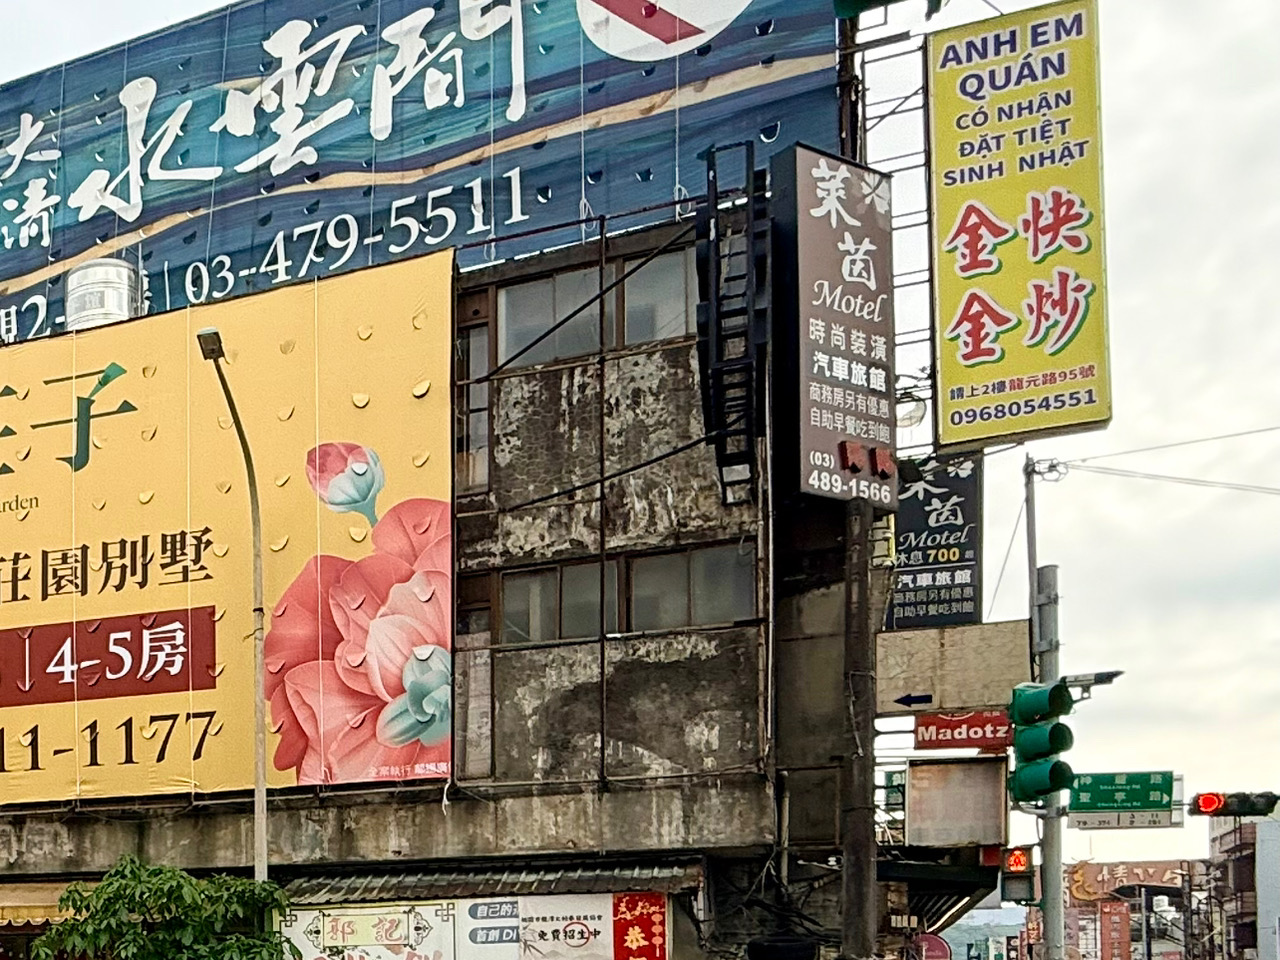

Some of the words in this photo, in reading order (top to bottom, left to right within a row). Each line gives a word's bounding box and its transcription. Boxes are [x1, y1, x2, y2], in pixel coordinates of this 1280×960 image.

[939, 29, 1017, 69] ANH
[1031, 13, 1083, 48] EM
[959, 52, 1065, 101] QUÁN
[956, 105, 989, 130] CÓ
[997, 90, 1072, 122] NHẬN
[944, 161, 1004, 186] SINH
[1019, 140, 1089, 172] NHẬT
[959, 133, 1006, 158] ĐẶT
[185, 168, 530, 304] 03-479-5511
[809, 158, 877, 291] 萊茵
[811, 280, 888, 324] Motel
[808, 318, 887, 362] 時尚裝潢
[812, 351, 887, 393] 汽車旅館
[808, 381, 890, 419] 商務房另有優惠
[950, 388, 1097, 426] 0968054551
[809, 406, 891, 444] 自助早餐吃到飽
[809, 450, 835, 469] (03)
[808, 469, 891, 503] 489-1566
[897, 524, 976, 551] Motel
[926, 548, 960, 563] 700
[897, 570, 971, 589] 汽車旅館
[46, 621, 186, 688] 4-5房
[917, 723, 1009, 741] Madotz
[327, 917, 405, 943] 郭記
[502, 928, 520, 941] DI
[537, 928, 602, 941] 免費招生中
